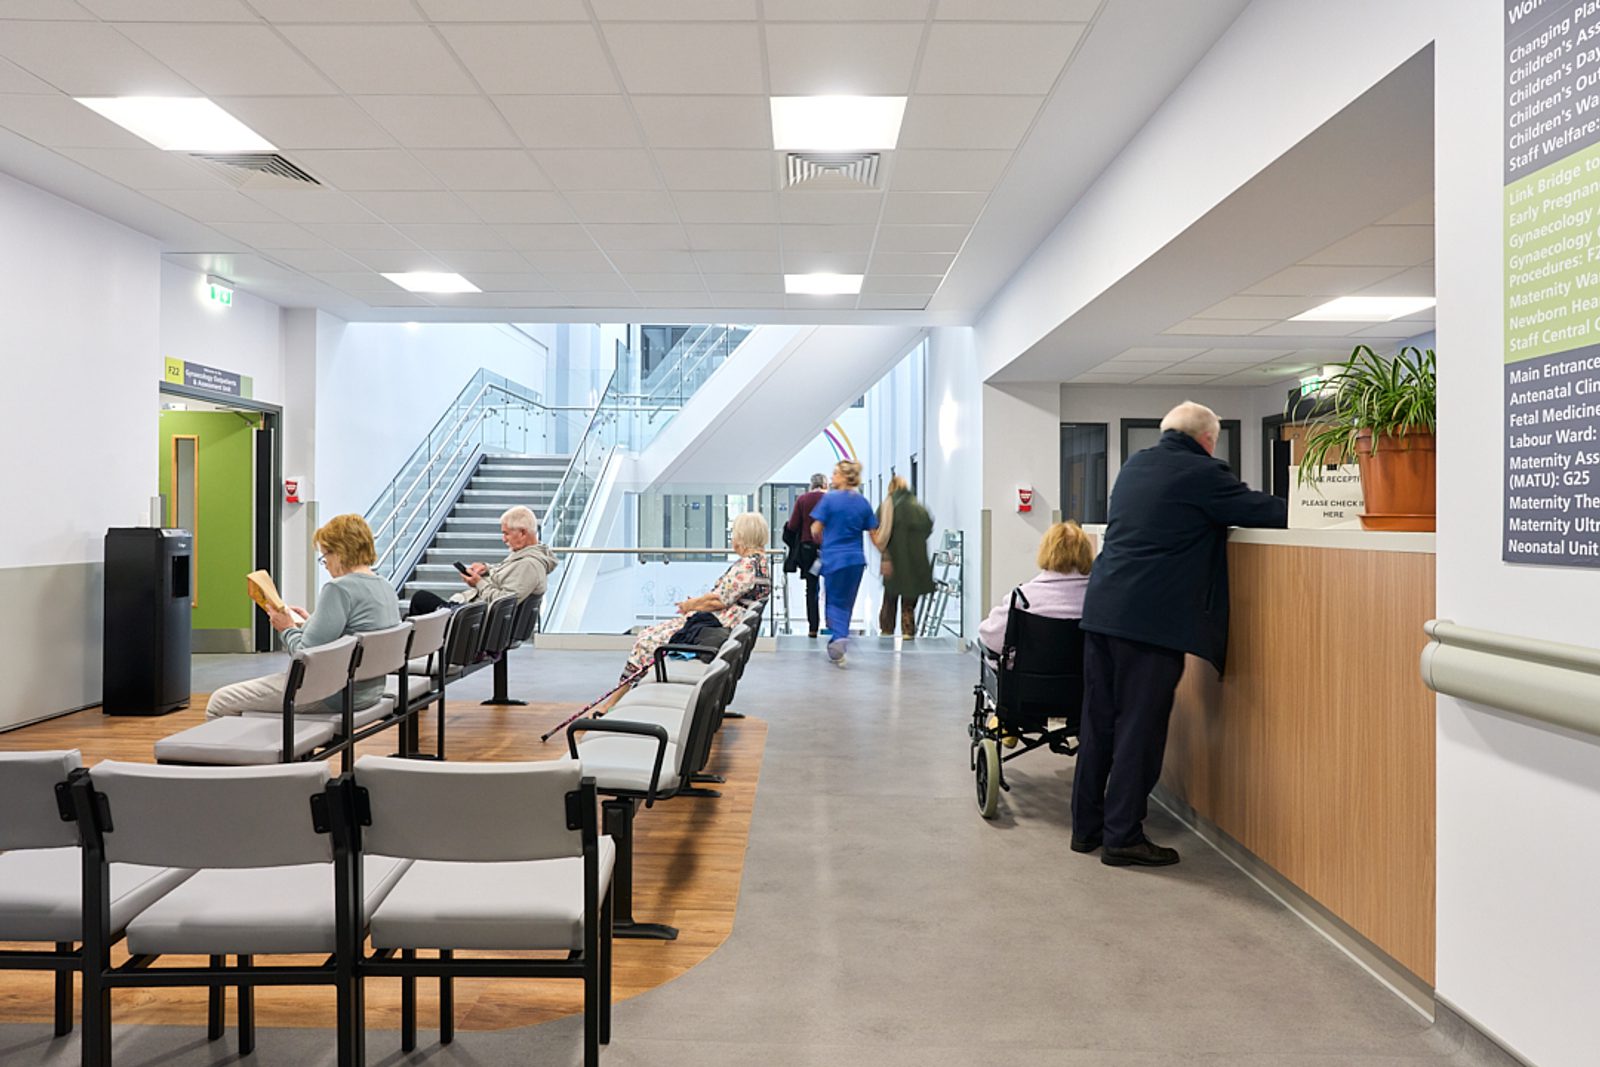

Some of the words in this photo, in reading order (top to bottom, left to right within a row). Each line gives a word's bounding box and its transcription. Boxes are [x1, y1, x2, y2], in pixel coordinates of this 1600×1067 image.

[1510, 18, 1570, 64] Changing
[1510, 40, 1572, 85] Children's
[1576, 22, 1600, 46] Ass
[1510, 62, 1572, 106] Children's
[1510, 85, 1572, 128] Children's
[1510, 108, 1572, 150] Children's
[1576, 95, 1599, 115] Wa
[1510, 144, 1540, 172] Staff
[1542, 118, 1600, 155] Welfare:
[1510, 184, 1534, 206] Link
[1538, 164, 1582, 193] Bridge
[1586, 158, 1600, 172] to
[1510, 204, 1539, 227] Early
[1543, 181, 1600, 214] Pregnan
[1509, 208, 1592, 248] Gynaecology
[1509, 231, 1592, 270] Gynaecology
[1510, 254, 1583, 288] Procedures:
[1510, 282, 1571, 309] Maternity
[1576, 272, 1600, 289] Wa
[1510, 306, 1567, 330] Newborn
[1572, 296, 1599, 314] Hea
[1510, 332, 1538, 352] Staff
[1542, 319, 1590, 344] Central
[168, 366, 180, 376] F22
[1510, 367, 1540, 385] Main
[1544, 357, 1600, 378] Entrance
[1510, 382, 1571, 406] Antenatal
[1575, 378, 1600, 396] Clin
[1510, 410, 1539, 428] Fetal
[1542, 405, 1600, 423] Medicine
[1510, 434, 1552, 449] Labour
[1555, 426, 1597, 444] Ward:
[1510, 452, 1571, 470] Maternity
[1575, 451, 1600, 466] Ass
[1509, 471, 1559, 490] (MATU):
[1563, 470, 1590, 486] G25
[1510, 494, 1571, 512] Maternity
[1574, 493, 1600, 509] The
[1509, 517, 1571, 535] Maternity
[1508, 539, 1564, 555] Neonatal
[1569, 540, 1599, 556] Unit
